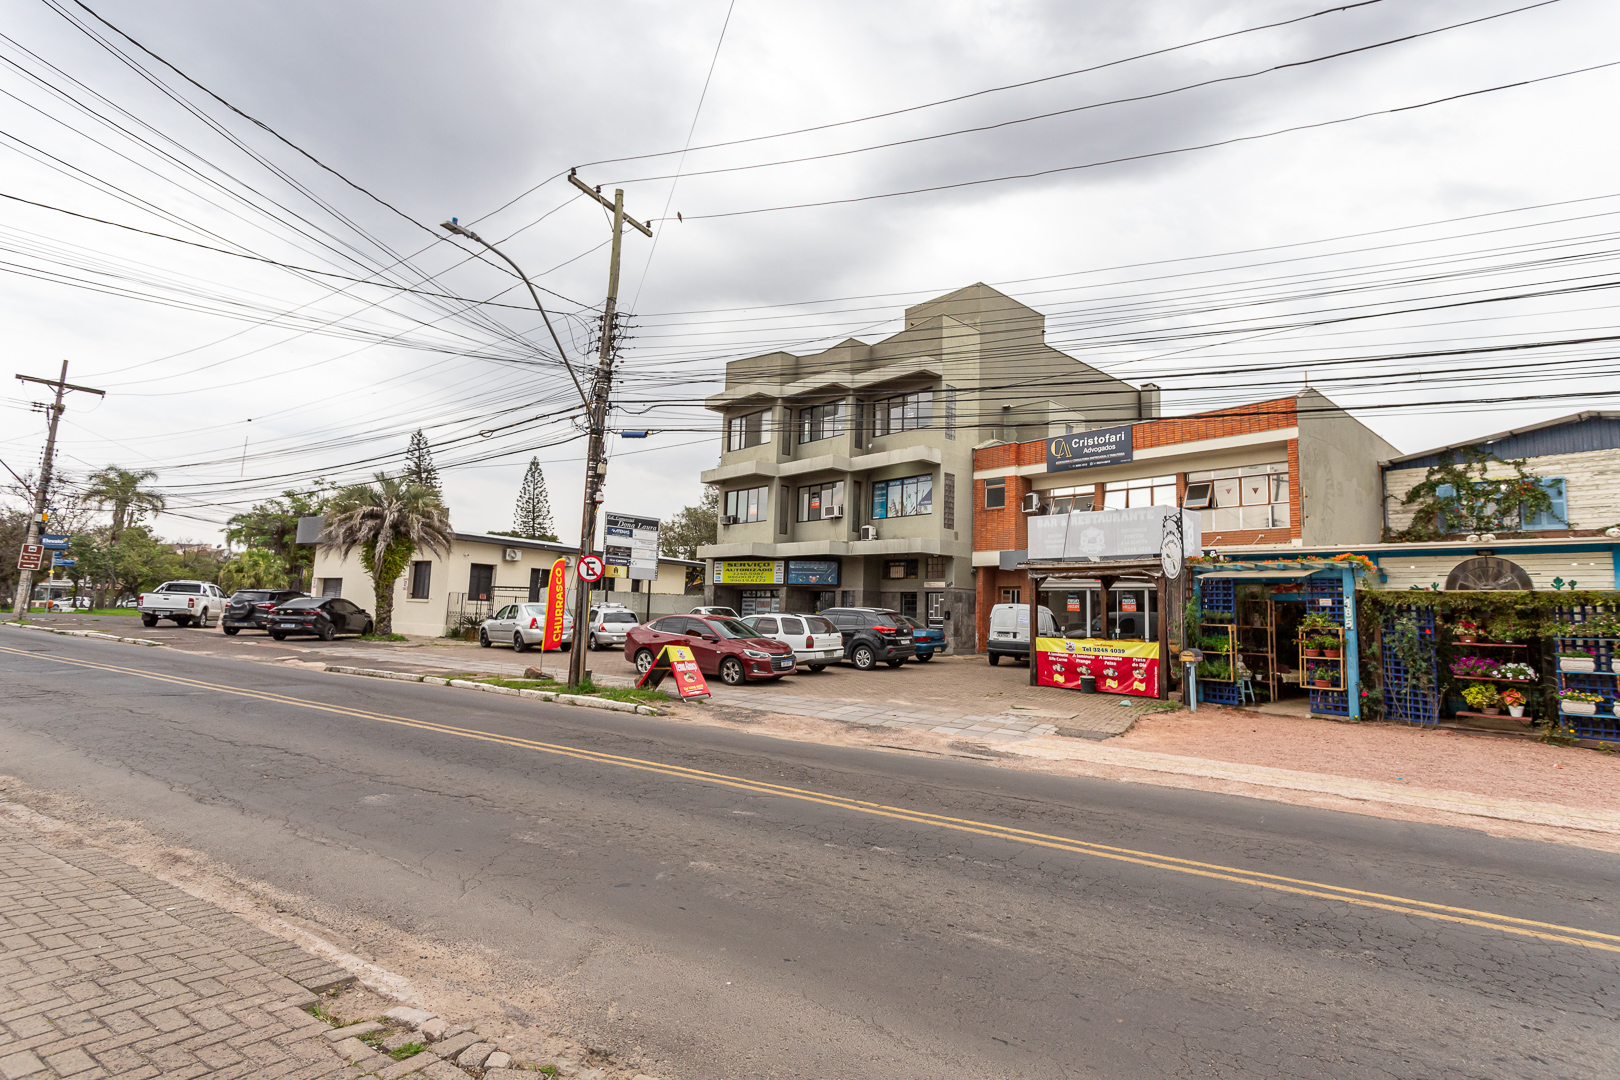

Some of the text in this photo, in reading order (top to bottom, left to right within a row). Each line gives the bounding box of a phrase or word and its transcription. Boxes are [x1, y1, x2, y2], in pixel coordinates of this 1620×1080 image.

[1072, 431, 1125, 447] Cristofari
[1083, 444, 1116, 454] Advogados
[637, 523, 657, 531] Laura
[1036, 518, 1057, 528] BAR
[1071, 510, 1154, 525] RESTAURANTE
[586, 561, 596, 576] E
[553, 567, 563, 642] CHURRASCO
[1344, 599, 1352, 627] 185
